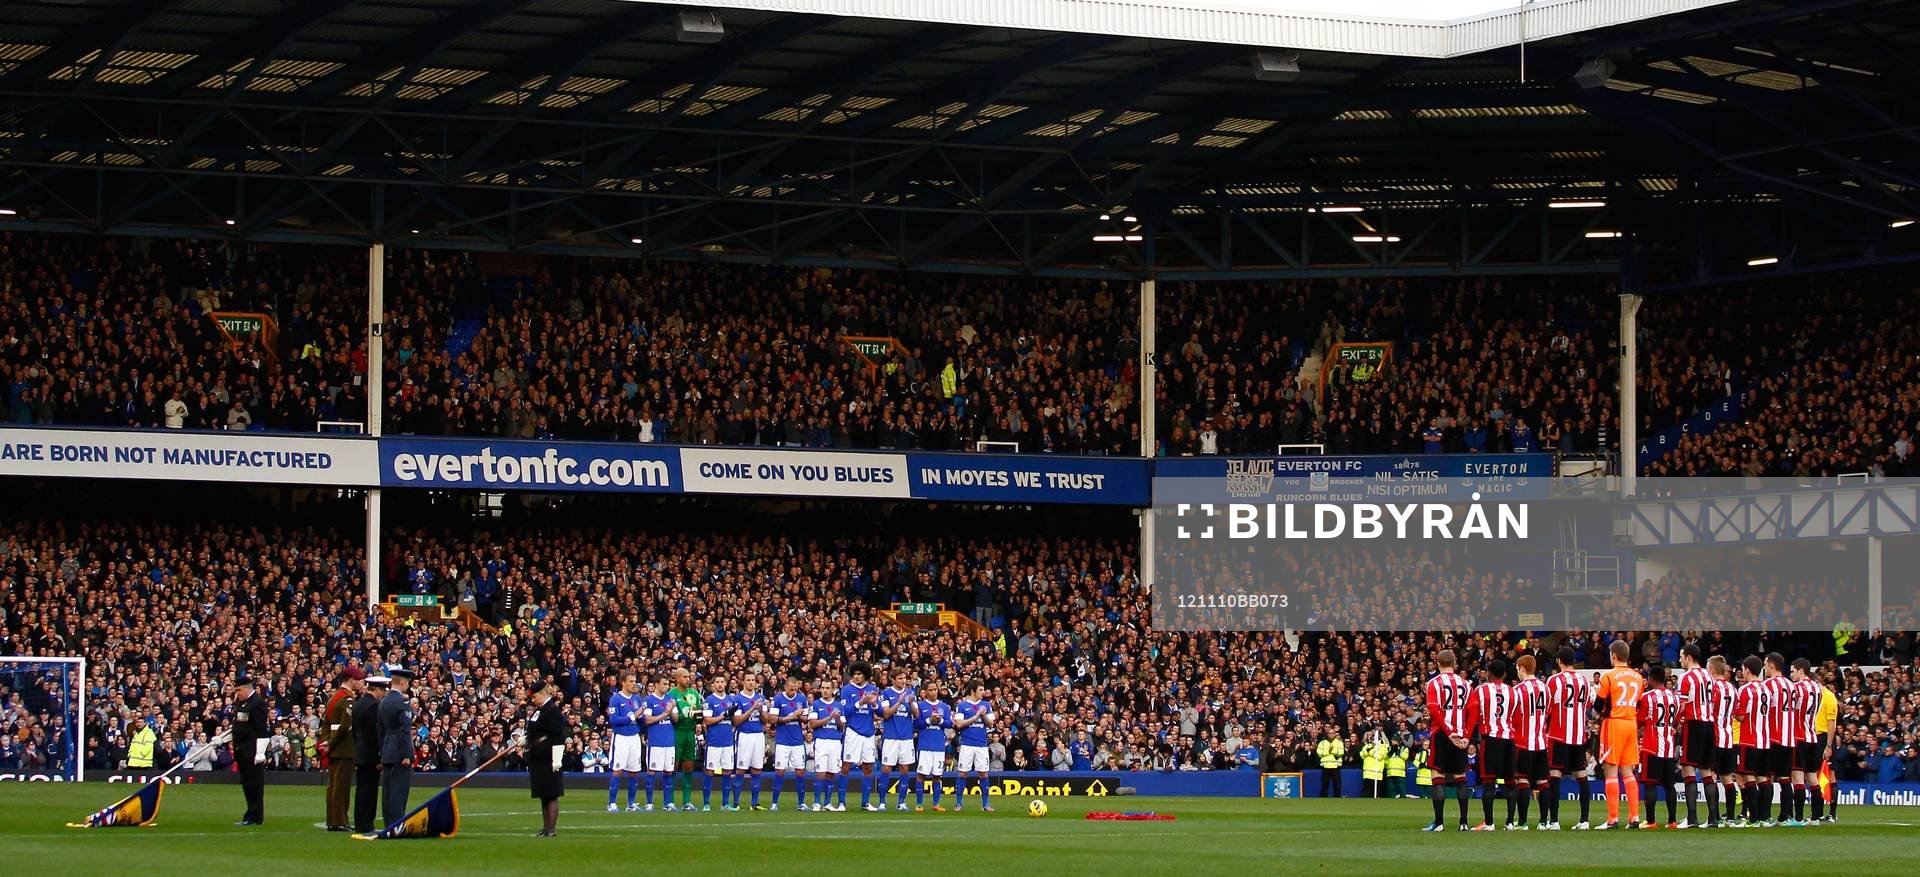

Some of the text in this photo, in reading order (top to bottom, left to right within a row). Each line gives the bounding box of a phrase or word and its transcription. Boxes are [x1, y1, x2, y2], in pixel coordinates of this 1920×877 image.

[373, 323, 382, 336] J
[1146, 353, 1155, 365] K
[1641, 445, 1648, 454] A
[1660, 435, 1666, 444] B
[1683, 424, 1688, 432] C
[1705, 412, 1711, 420] D
[1723, 403, 1728, 411] E
[1, 444, 332, 469] ARE BORN NOT MANUFACTURED
[394, 447, 670, 487] evertonfc.com
[1278, 461, 1362, 471] EVERTON FC
[1465, 463, 1528, 474] EVERTON
[699, 463, 894, 483] COME ON YOU BLUES
[922, 468, 1105, 490] IN MOYES WE TRUST
[1375, 470, 1439, 482] NIL SATIS
[1276, 493, 1363, 502] RUNCORN BLUES
[1367, 484, 1448, 496] NISI OPTIMUM
[1478, 483, 1512, 493] MAGIC
[1442, 685, 1467, 710] 23
[1495, 693, 1504, 717] 3
[1529, 691, 1546, 716] 14
[1565, 684, 1586, 708] 24
[1616, 682, 1638, 706] 22
[1701, 681, 1712, 705] 16
[1760, 692, 1768, 716] 8
[1781, 688, 1797, 712] 26
[1656, 703, 1676, 727] 28
[1723, 696, 1732, 718] 7
